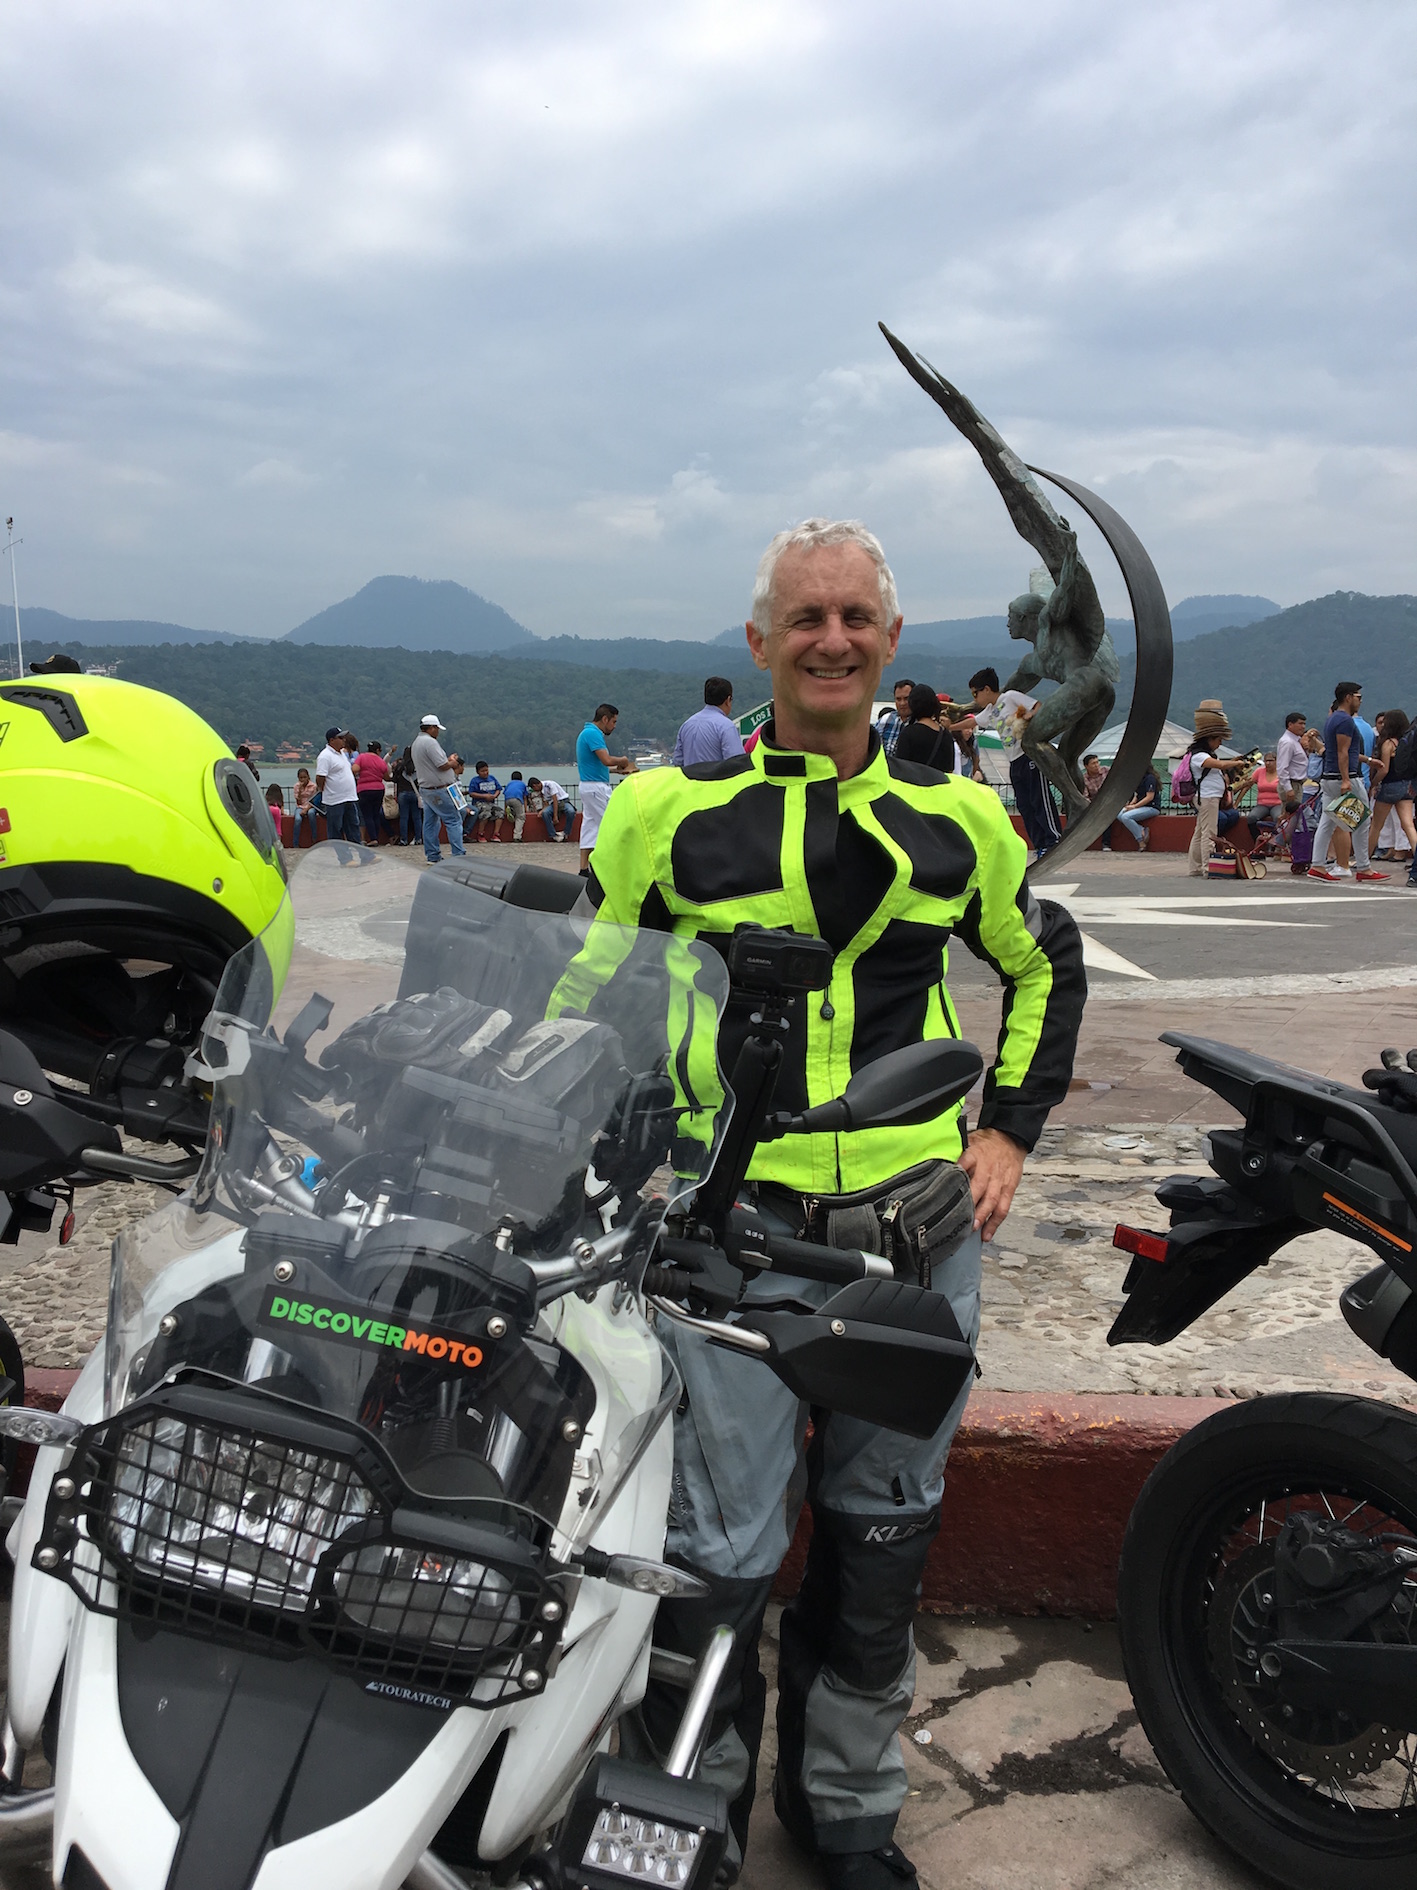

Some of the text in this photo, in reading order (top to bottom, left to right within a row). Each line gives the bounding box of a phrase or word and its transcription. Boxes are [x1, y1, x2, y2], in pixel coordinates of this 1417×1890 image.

[1338, 806, 1361, 823] INDIO
[746, 957, 772, 965] GARMIN
[269, 1296, 484, 1369] DISCOVERMOTO
[378, 1682, 452, 1709] TOURATECH
